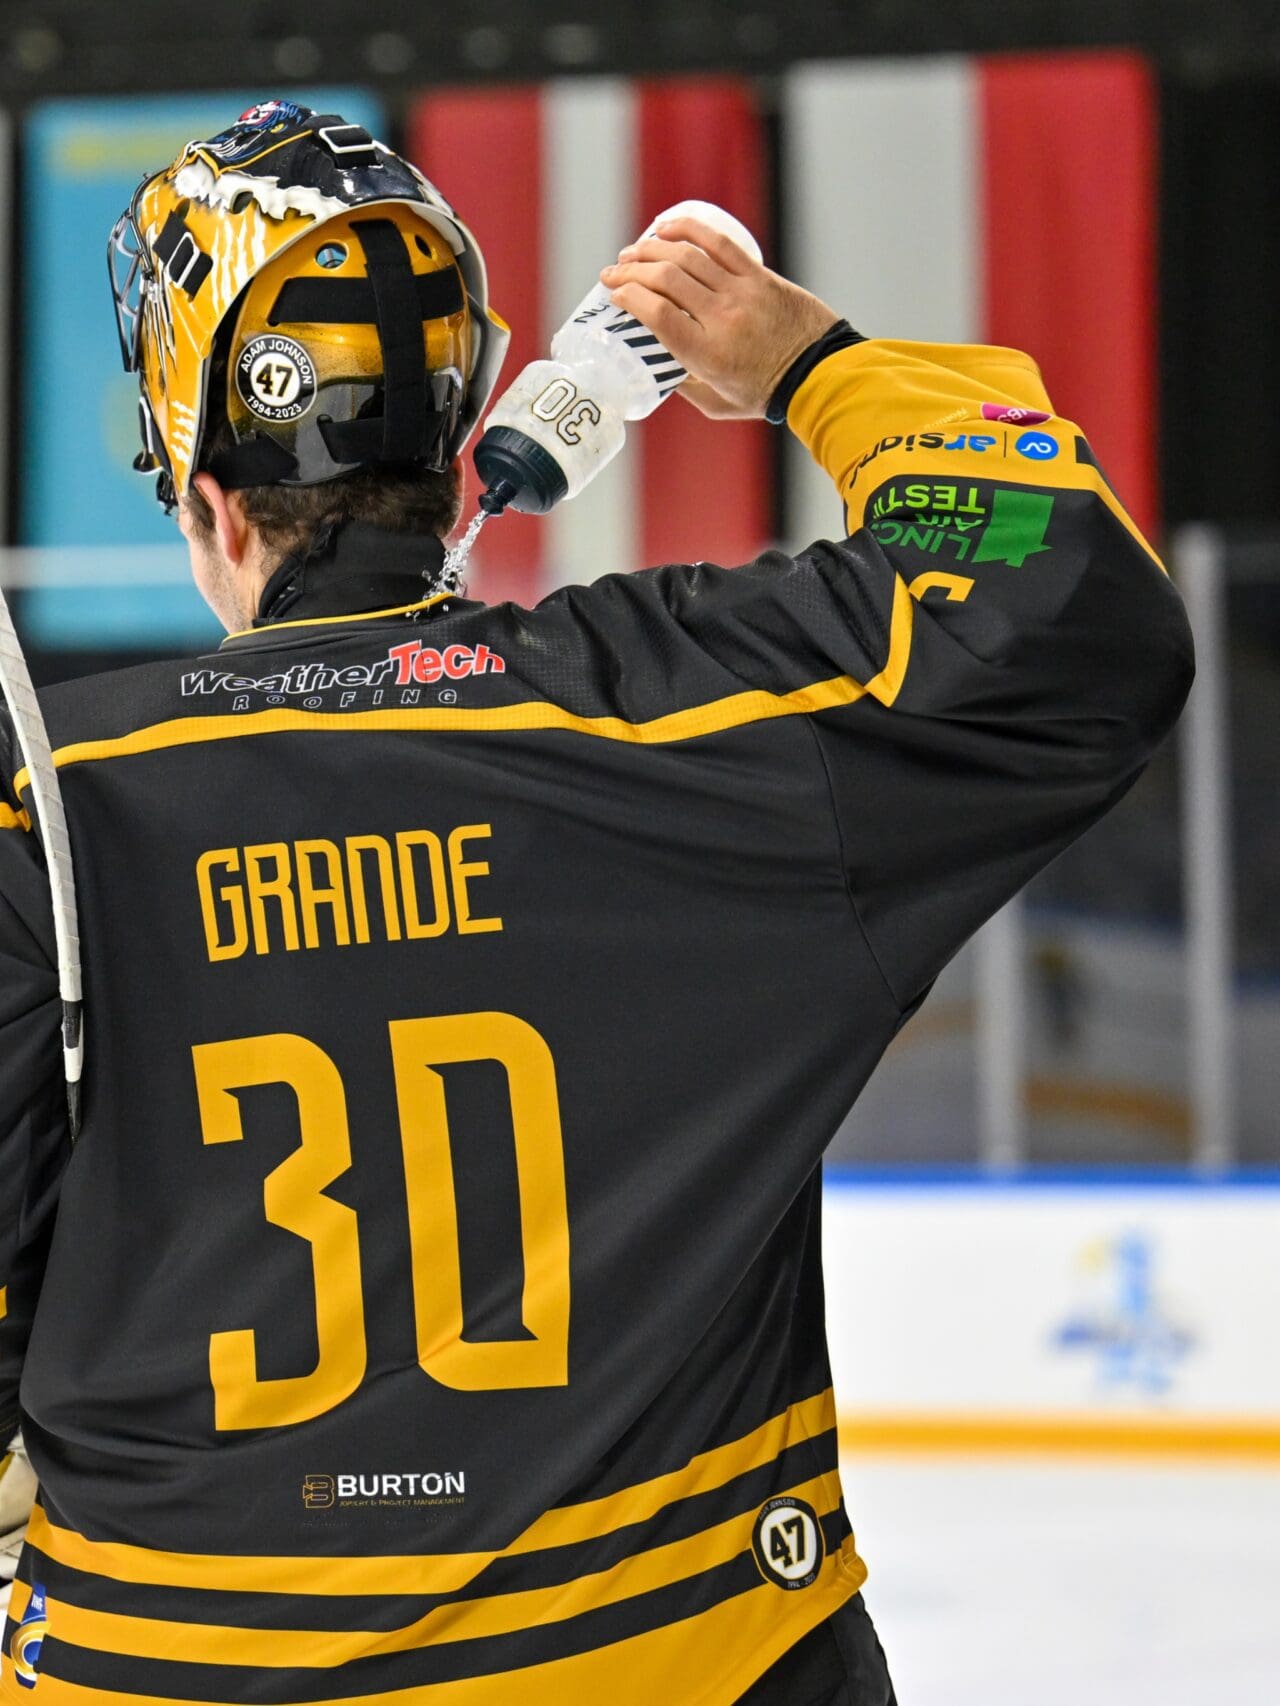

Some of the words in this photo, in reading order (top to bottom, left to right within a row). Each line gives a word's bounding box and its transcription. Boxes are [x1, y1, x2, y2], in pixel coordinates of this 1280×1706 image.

[241, 340, 266, 373] ADAM
[269, 339, 312, 384] JOHNSON
[256, 362, 293, 398] 47
[247, 395, 302, 418] 1994-2023
[531, 378, 601, 446] 30
[232, 689, 457, 711] ROOFING
[195, 824, 503, 962] GRANDE
[192, 1011, 570, 1431] 30
[337, 1471, 465, 1497] BURTON
[770, 1515, 806, 1569] 47
